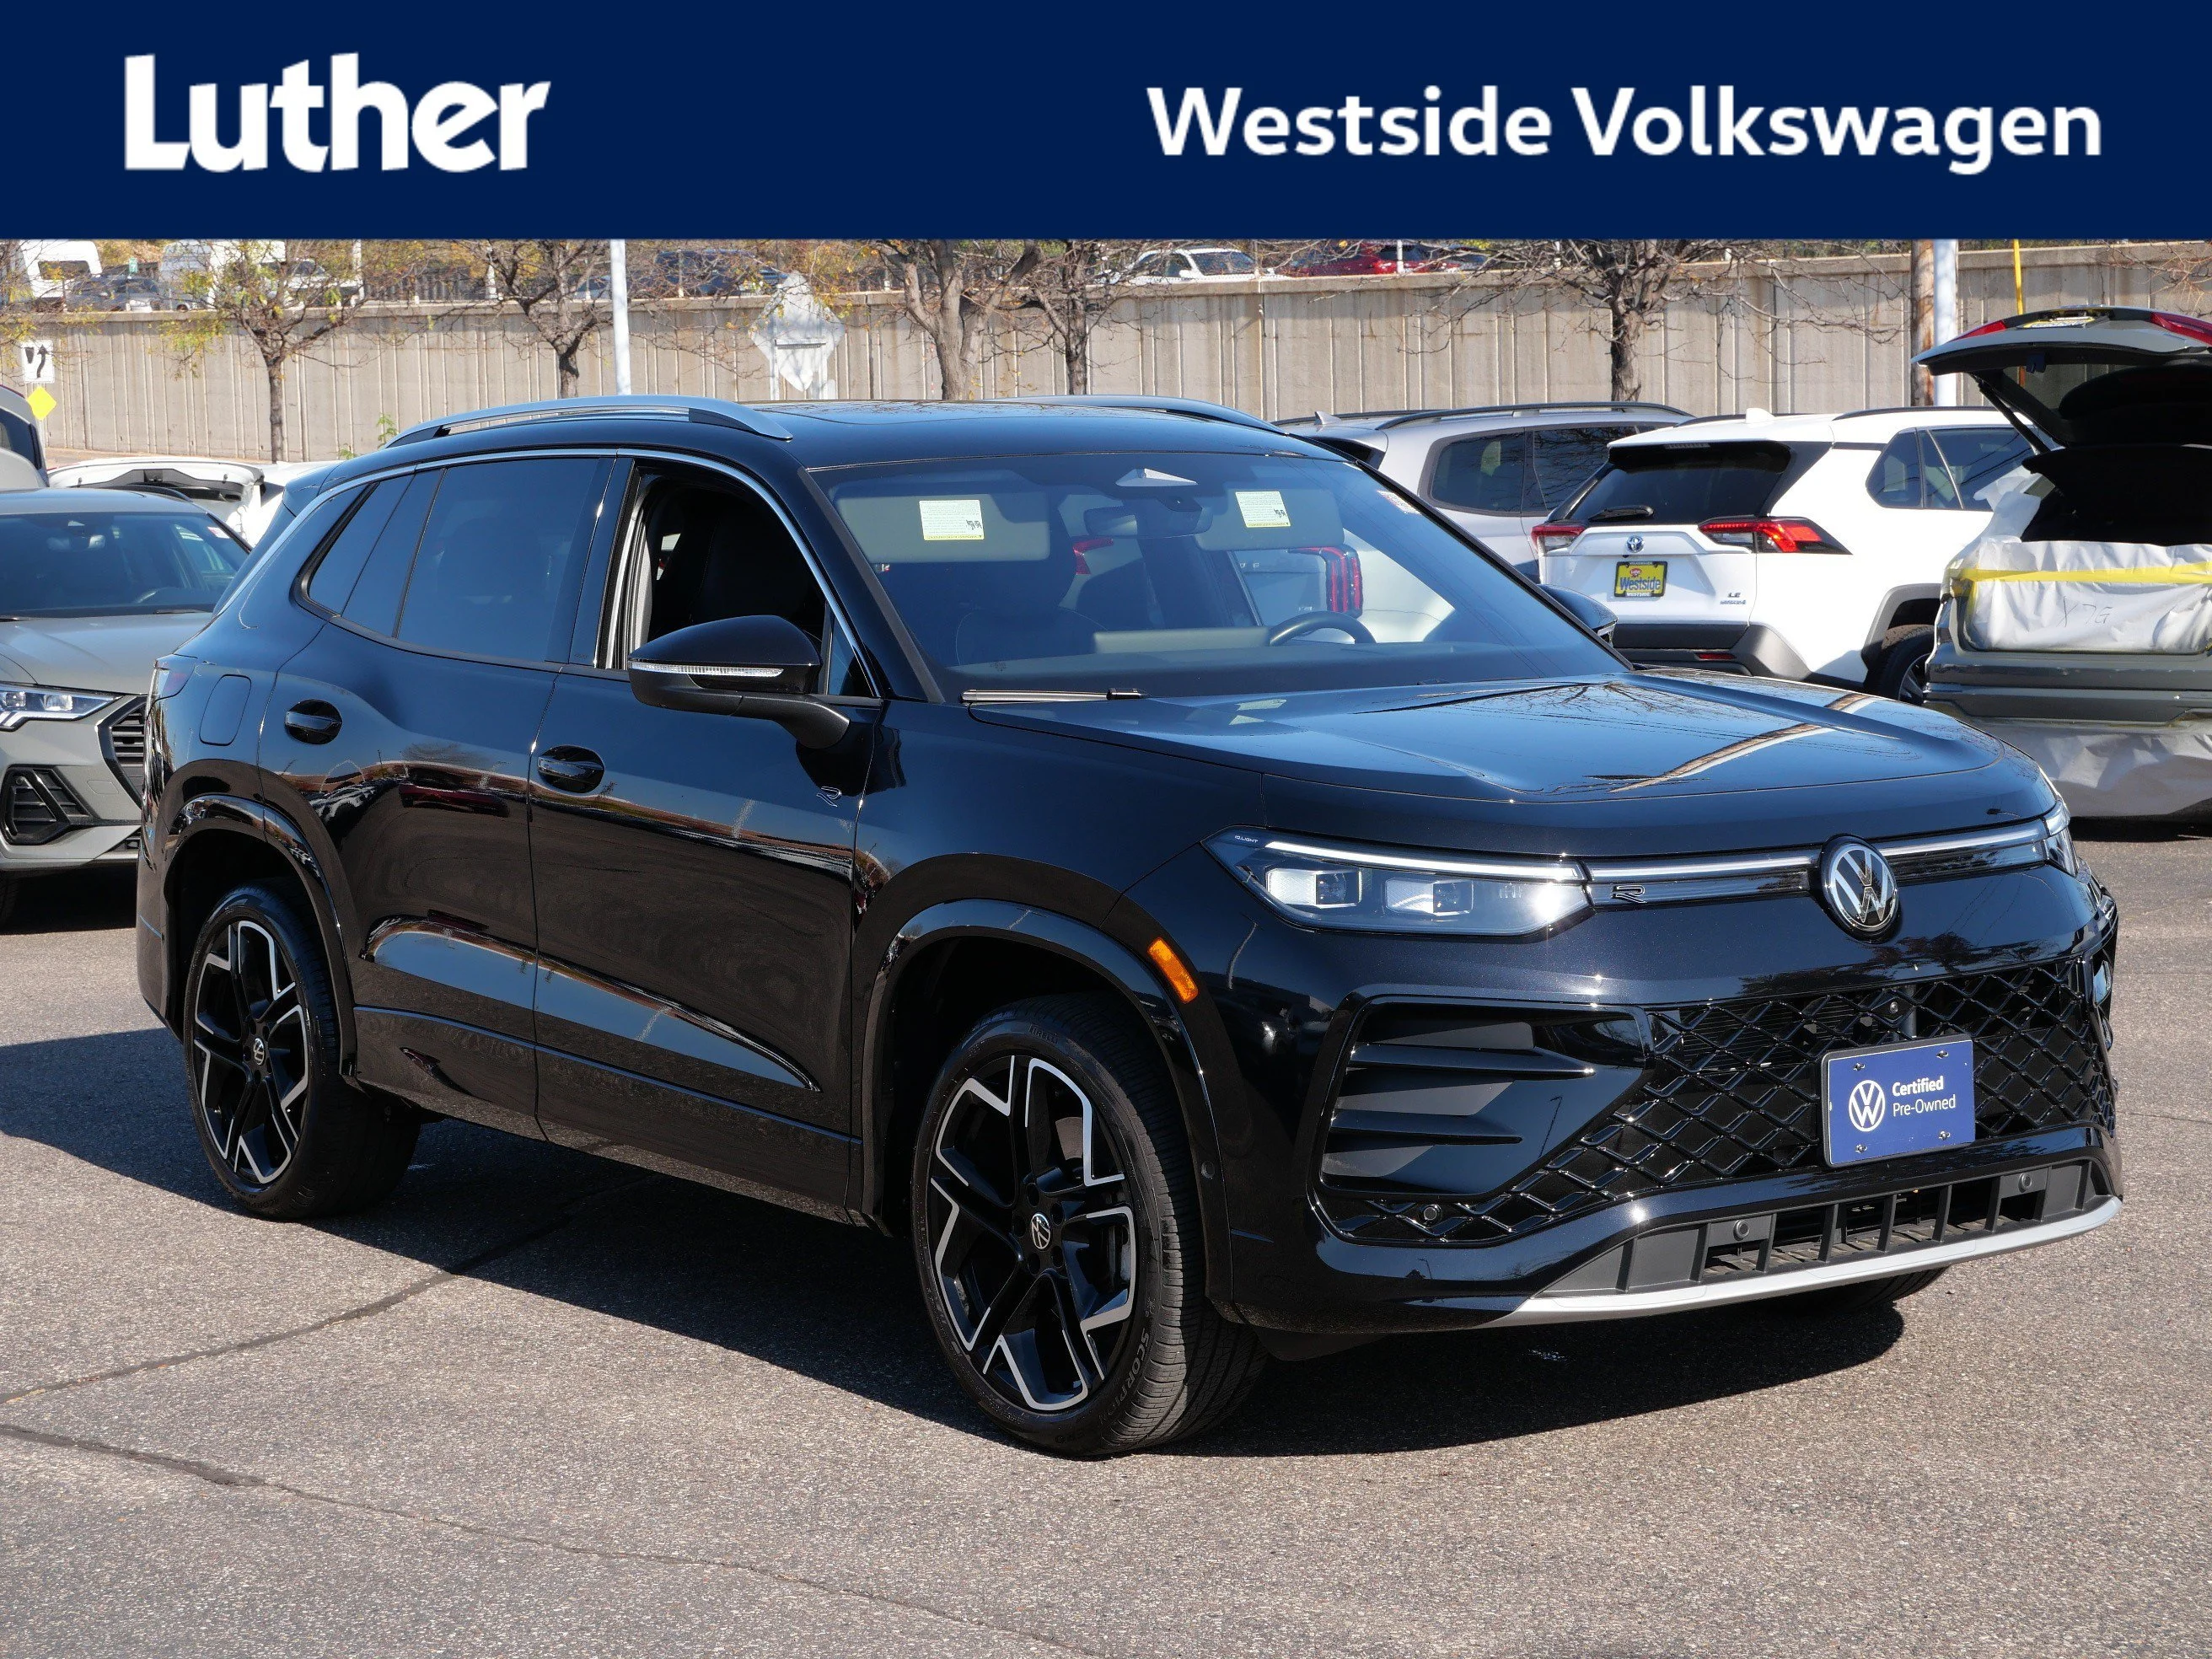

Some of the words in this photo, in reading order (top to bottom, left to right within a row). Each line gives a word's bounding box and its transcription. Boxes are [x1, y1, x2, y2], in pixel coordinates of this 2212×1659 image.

[1619, 577, 1661, 591] Westside
[1892, 1075, 1945, 1097] Certified
[1849, 1079, 1886, 1132] VW
[1893, 1093, 1957, 1117] Pre-Owned
